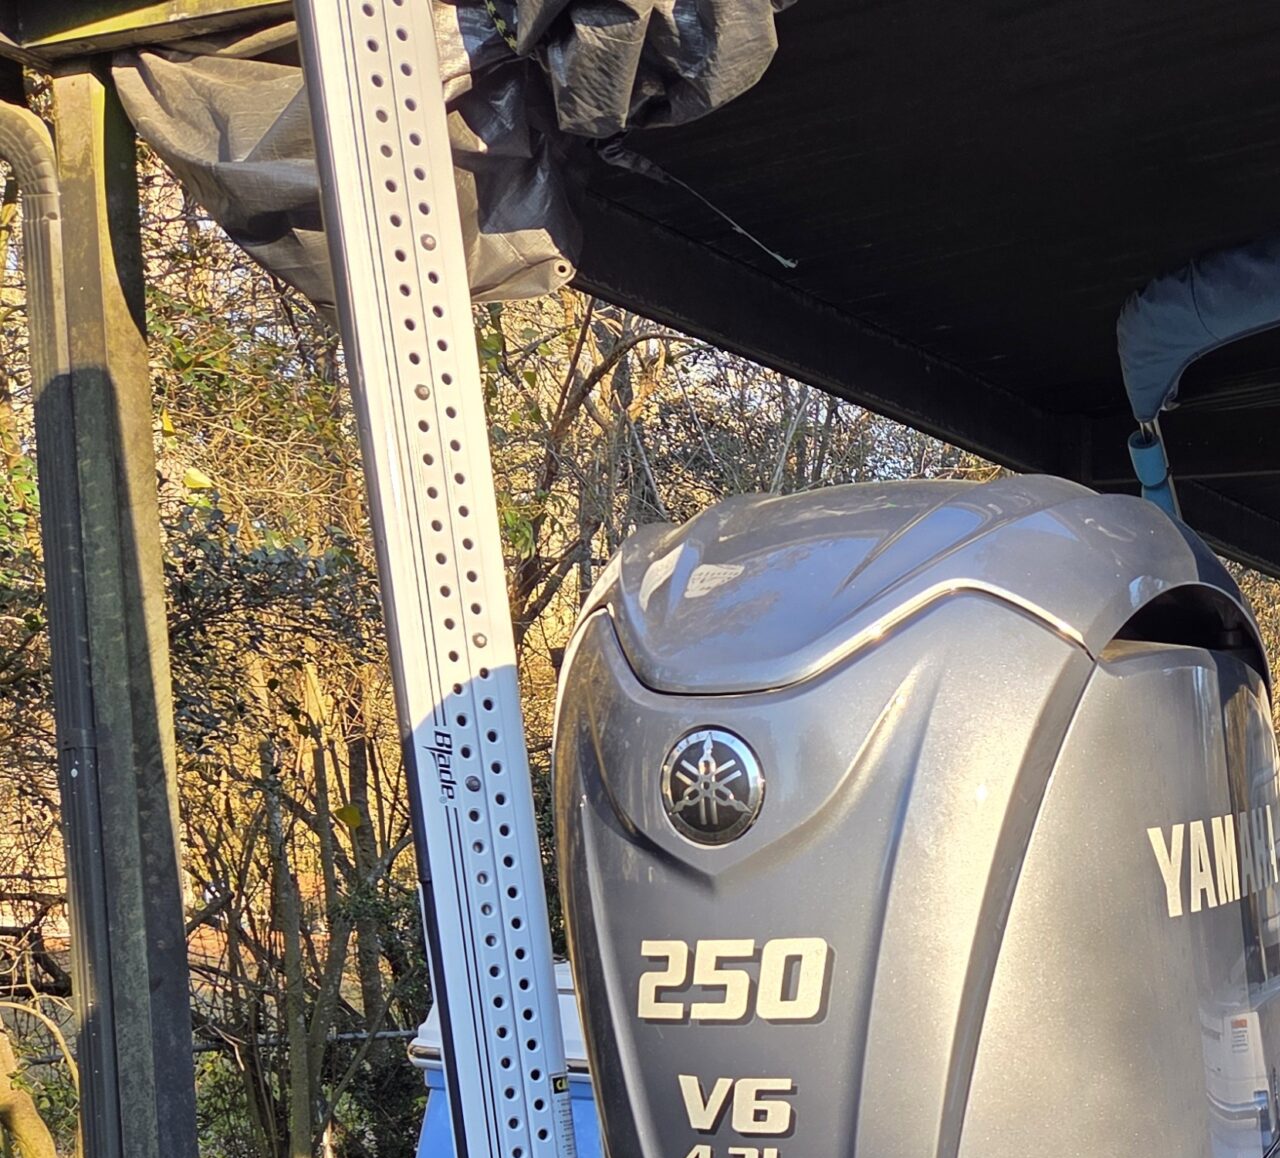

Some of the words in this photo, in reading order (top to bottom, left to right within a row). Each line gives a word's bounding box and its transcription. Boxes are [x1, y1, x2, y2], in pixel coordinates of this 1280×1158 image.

[422, 731, 457, 800] Blade
[637, 937, 832, 1022] 250
[678, 1074, 794, 1135] V6
